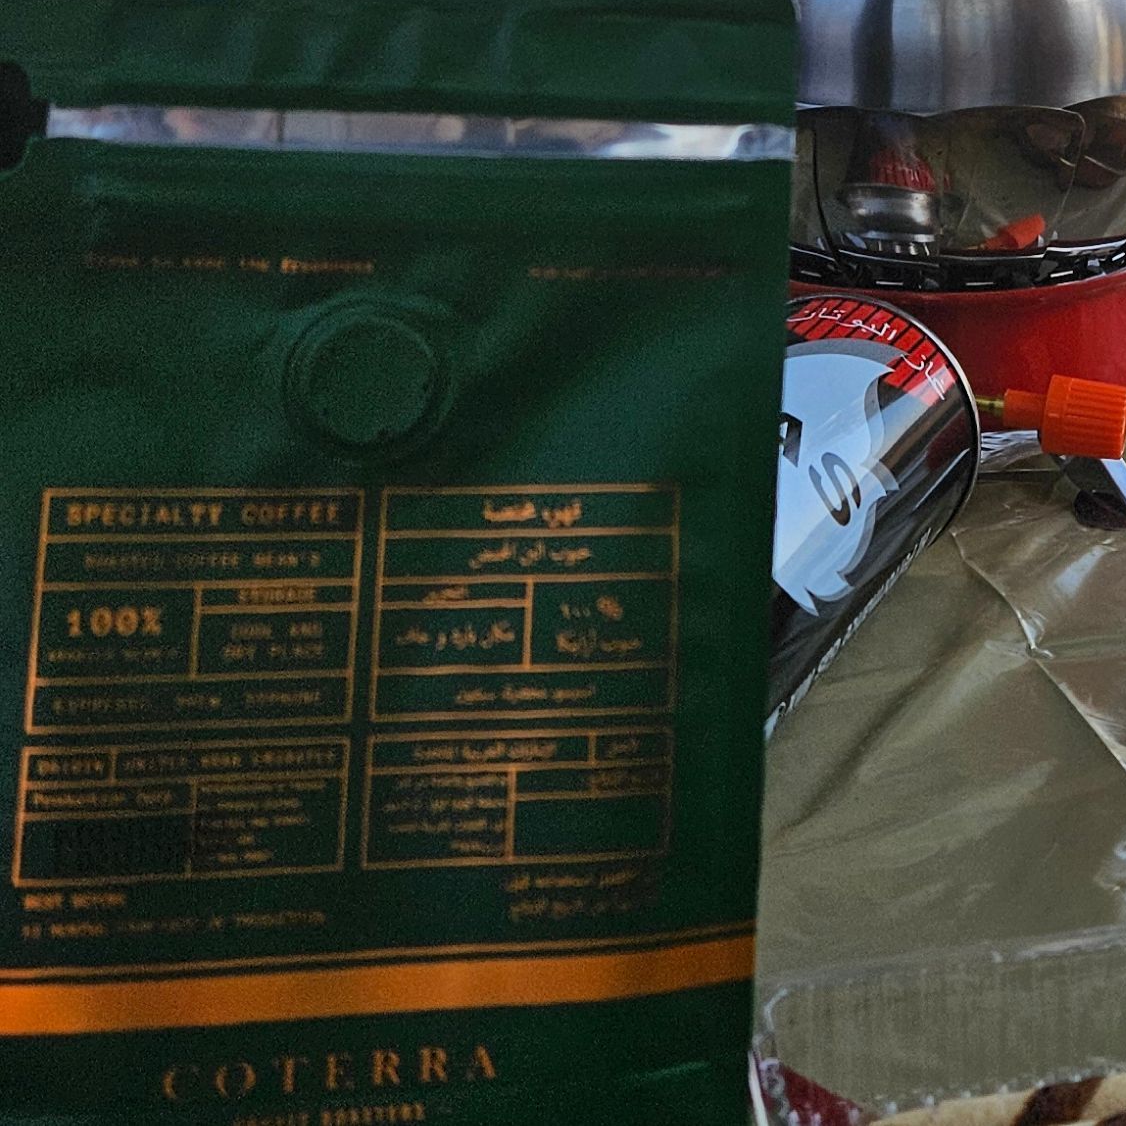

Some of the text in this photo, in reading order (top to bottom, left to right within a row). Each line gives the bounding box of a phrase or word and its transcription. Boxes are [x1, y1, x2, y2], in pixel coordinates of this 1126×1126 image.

[785, 306, 945, 401] غاز البوتان
[65, 500, 342, 527] SPECIALTY COFFEE
[66, 605, 164, 639] 100%
[161, 1042, 498, 1101] COTERRA
